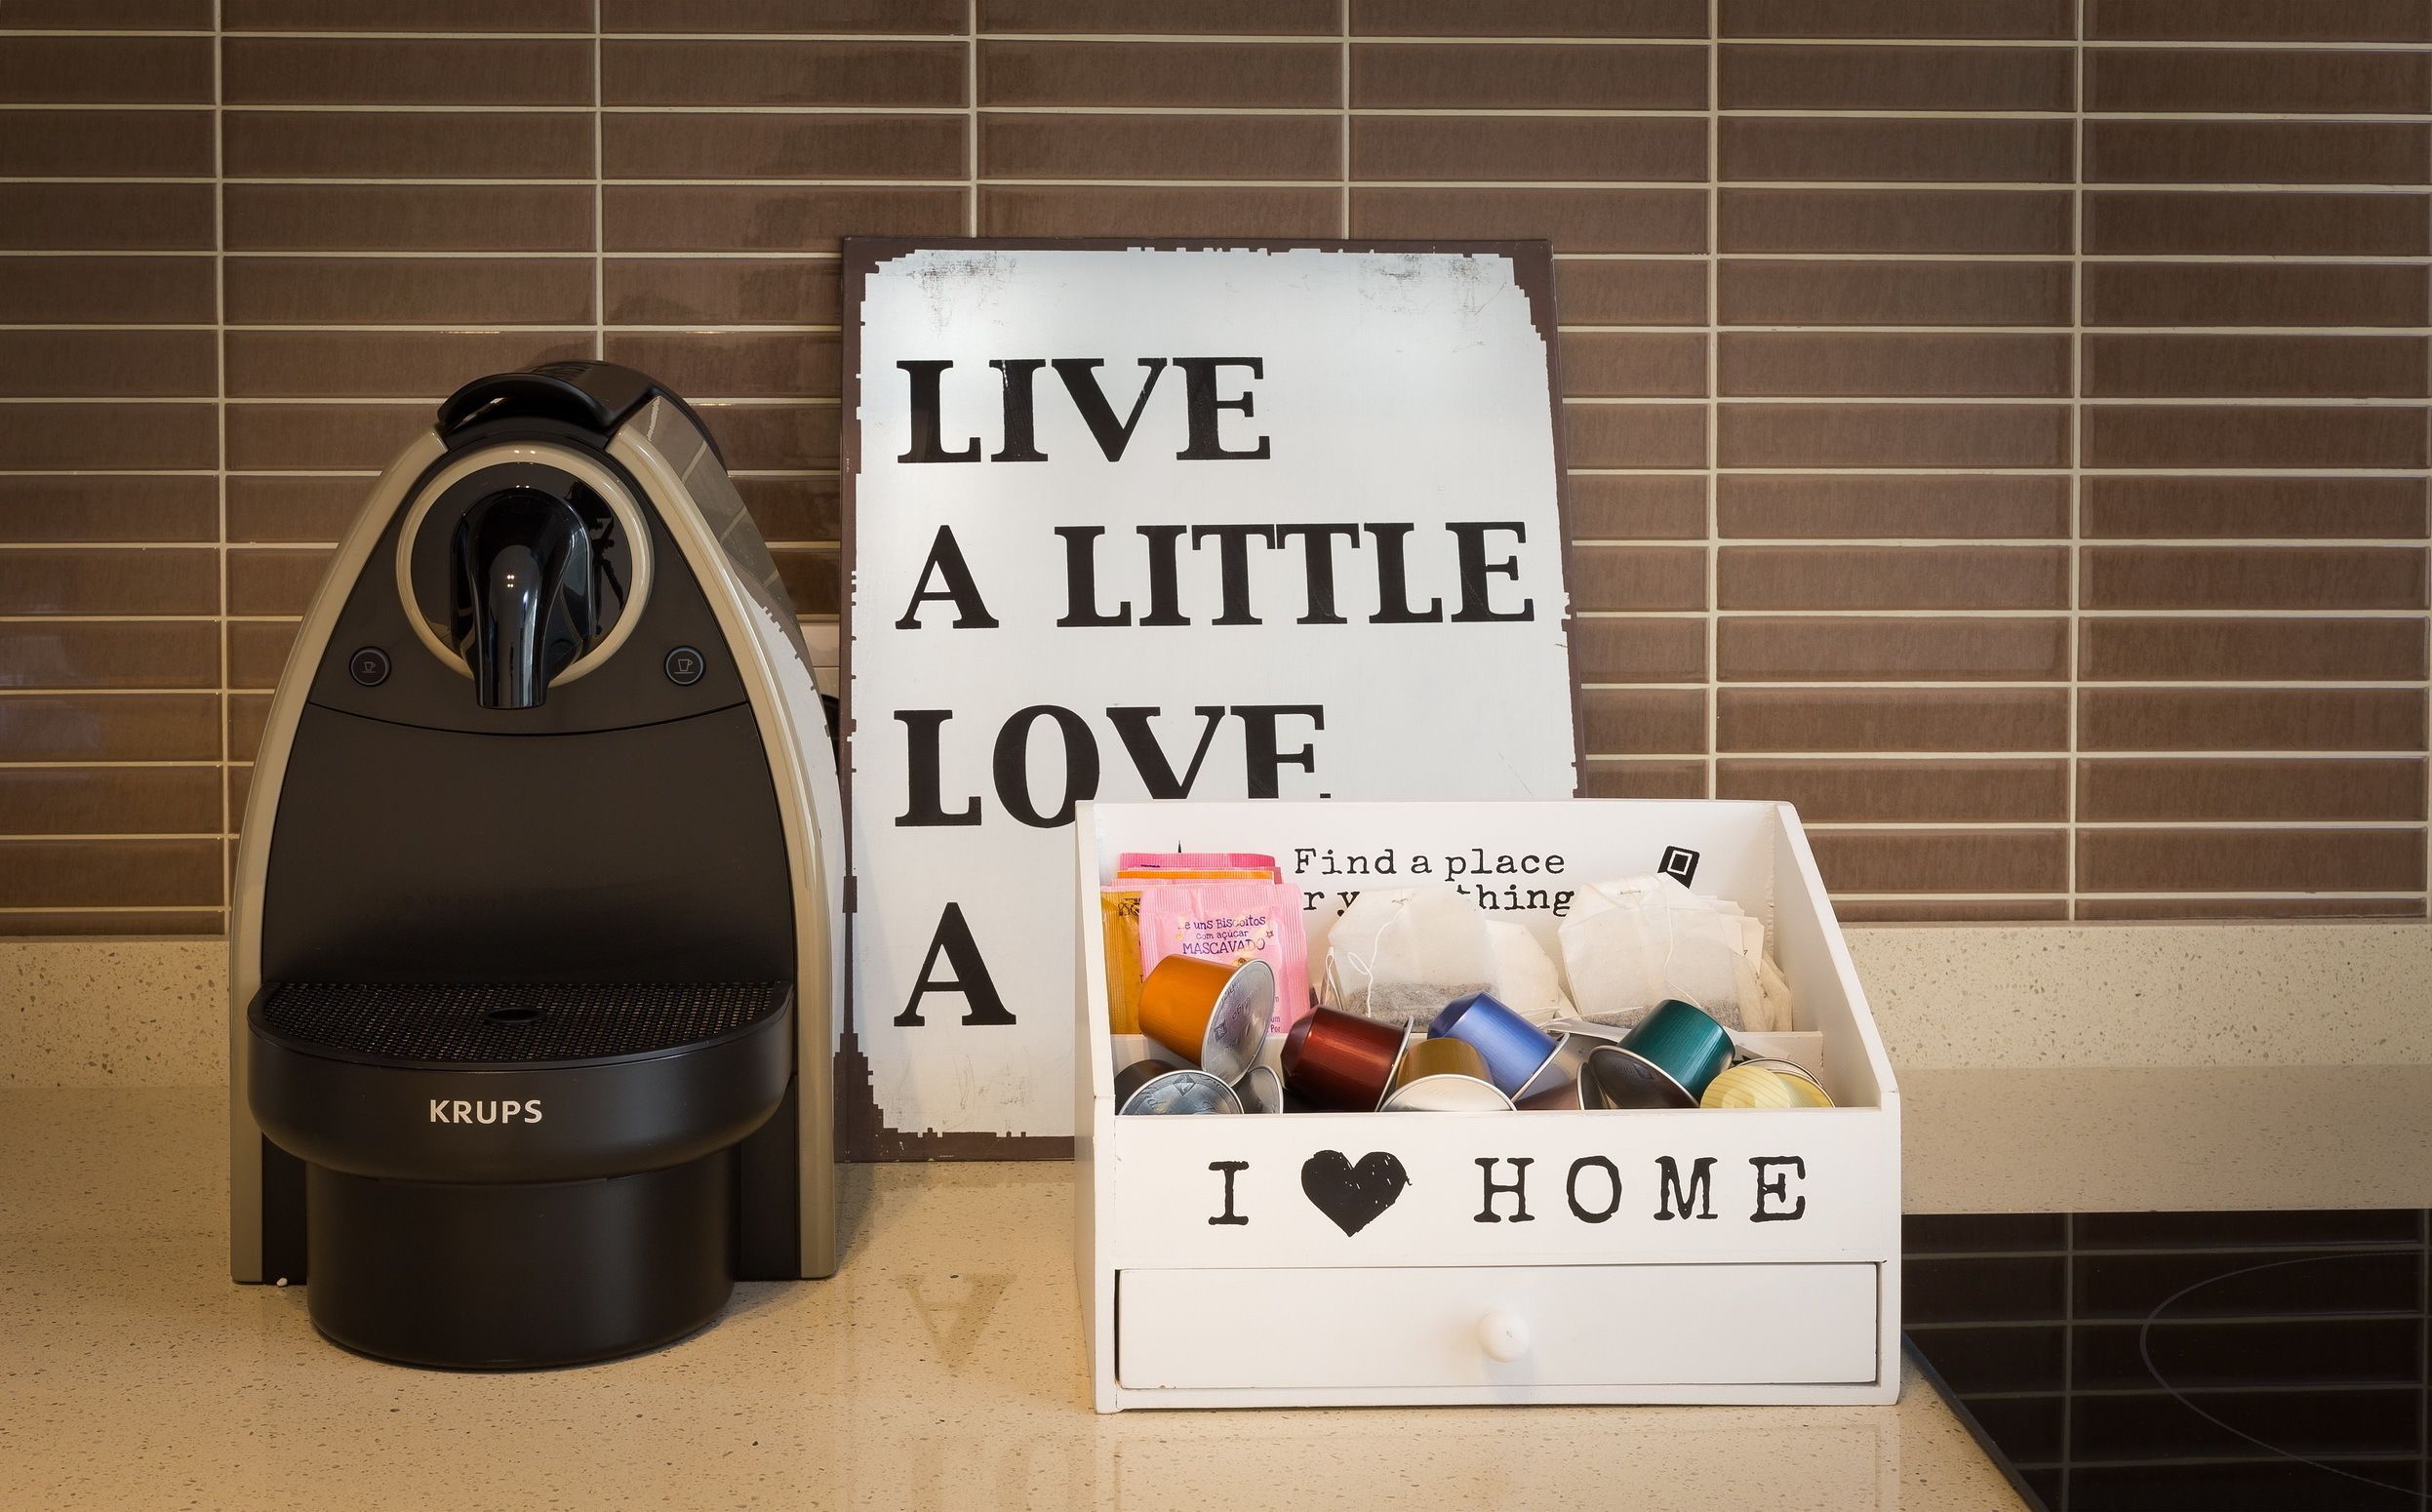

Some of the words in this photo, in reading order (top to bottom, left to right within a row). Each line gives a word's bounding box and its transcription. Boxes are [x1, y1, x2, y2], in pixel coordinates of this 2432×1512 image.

[896, 356, 1270, 463] LIVE
[895, 524, 1000, 630] A
[1054, 521, 1535, 628] LITTLE
[893, 704, 1332, 828] LOVE
[1294, 848, 1397, 875] Find
[1411, 855, 1433, 874] a
[1444, 848, 1565, 882] place
[893, 901, 1017, 1027] A
[1182, 937, 1266, 955] MASCAVADO
[429, 1099, 542, 1124] KRUPS
[1208, 1160, 1250, 1226] I
[1473, 1155, 1806, 1224] HOME
